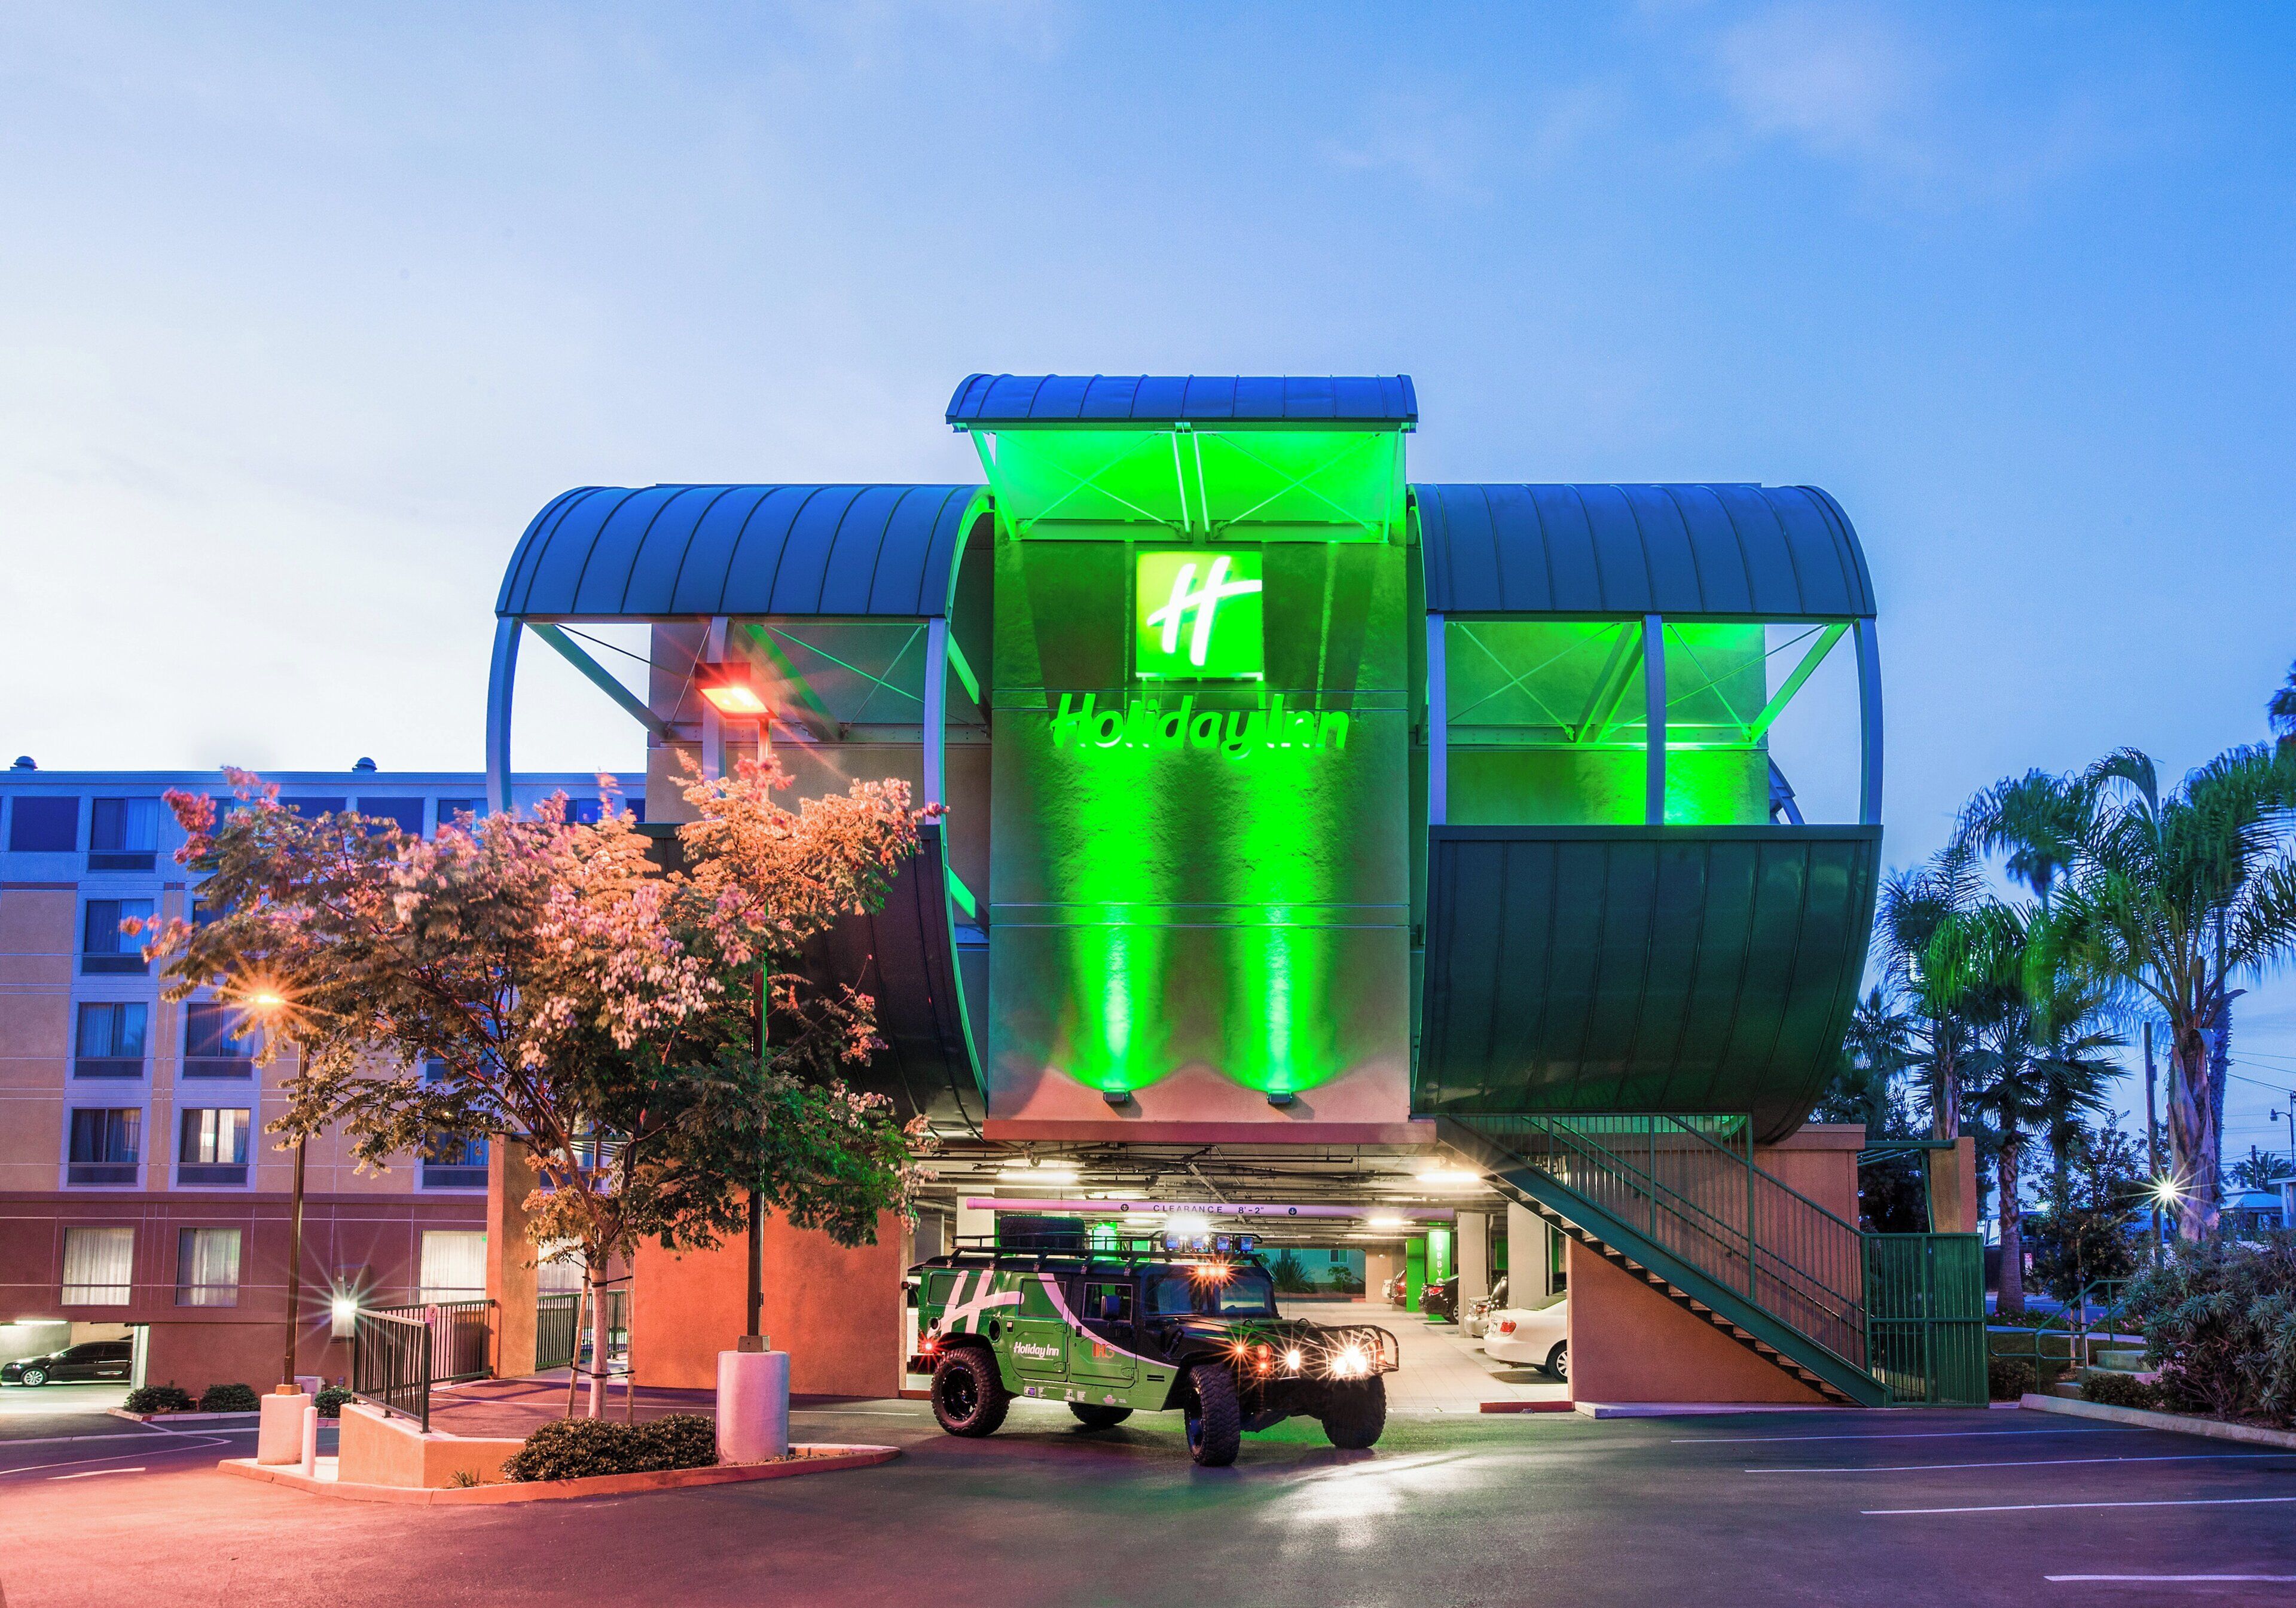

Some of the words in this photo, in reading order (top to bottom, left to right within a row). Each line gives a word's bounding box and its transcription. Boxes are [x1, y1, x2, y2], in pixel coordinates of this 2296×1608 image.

[1146, 555, 1263, 667] H
[1050, 693, 1254, 760] Holiday
[1265, 693, 1349, 748] Inn
[1153, 1205, 1223, 1213] CLEARANCE
[1013, 1341, 1046, 1358] Holiday
[1046, 1343, 1060, 1356] Inn
[1092, 1343, 1115, 1359] IHG
